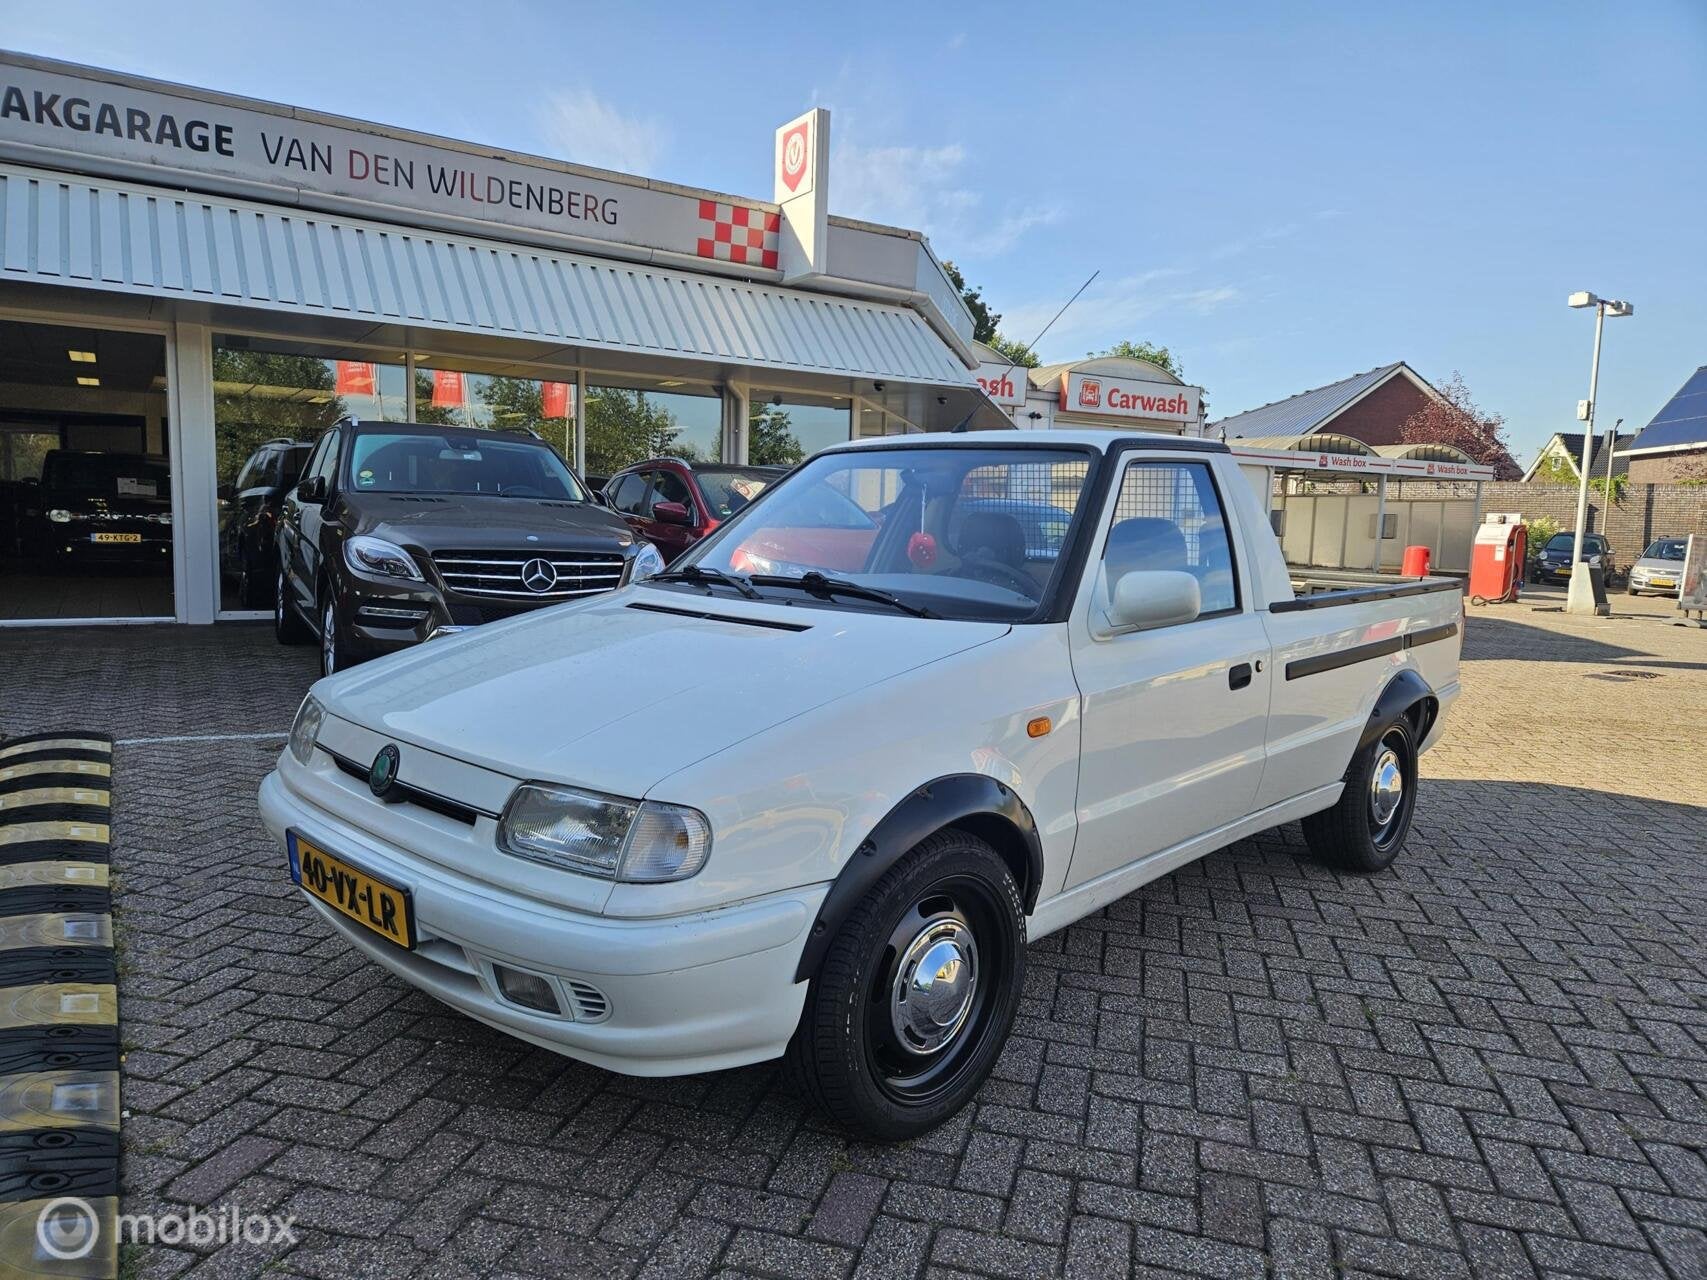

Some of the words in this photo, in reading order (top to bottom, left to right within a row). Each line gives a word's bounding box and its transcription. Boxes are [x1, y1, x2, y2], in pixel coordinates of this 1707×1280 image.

[1, 86, 234, 157] AKGARAGE
[260, 132, 333, 175] VAN
[349, 149, 414, 189] DEN
[427, 163, 618, 225] WILDENBERG
[1107, 388, 1188, 414] Carwash
[1331, 456, 1351, 467] Wash
[1353, 457, 1367, 467] box
[1437, 464, 1456, 474] Wash
[1457, 465, 1468, 474] box
[303, 851, 398, 935] 40-VX-LR
